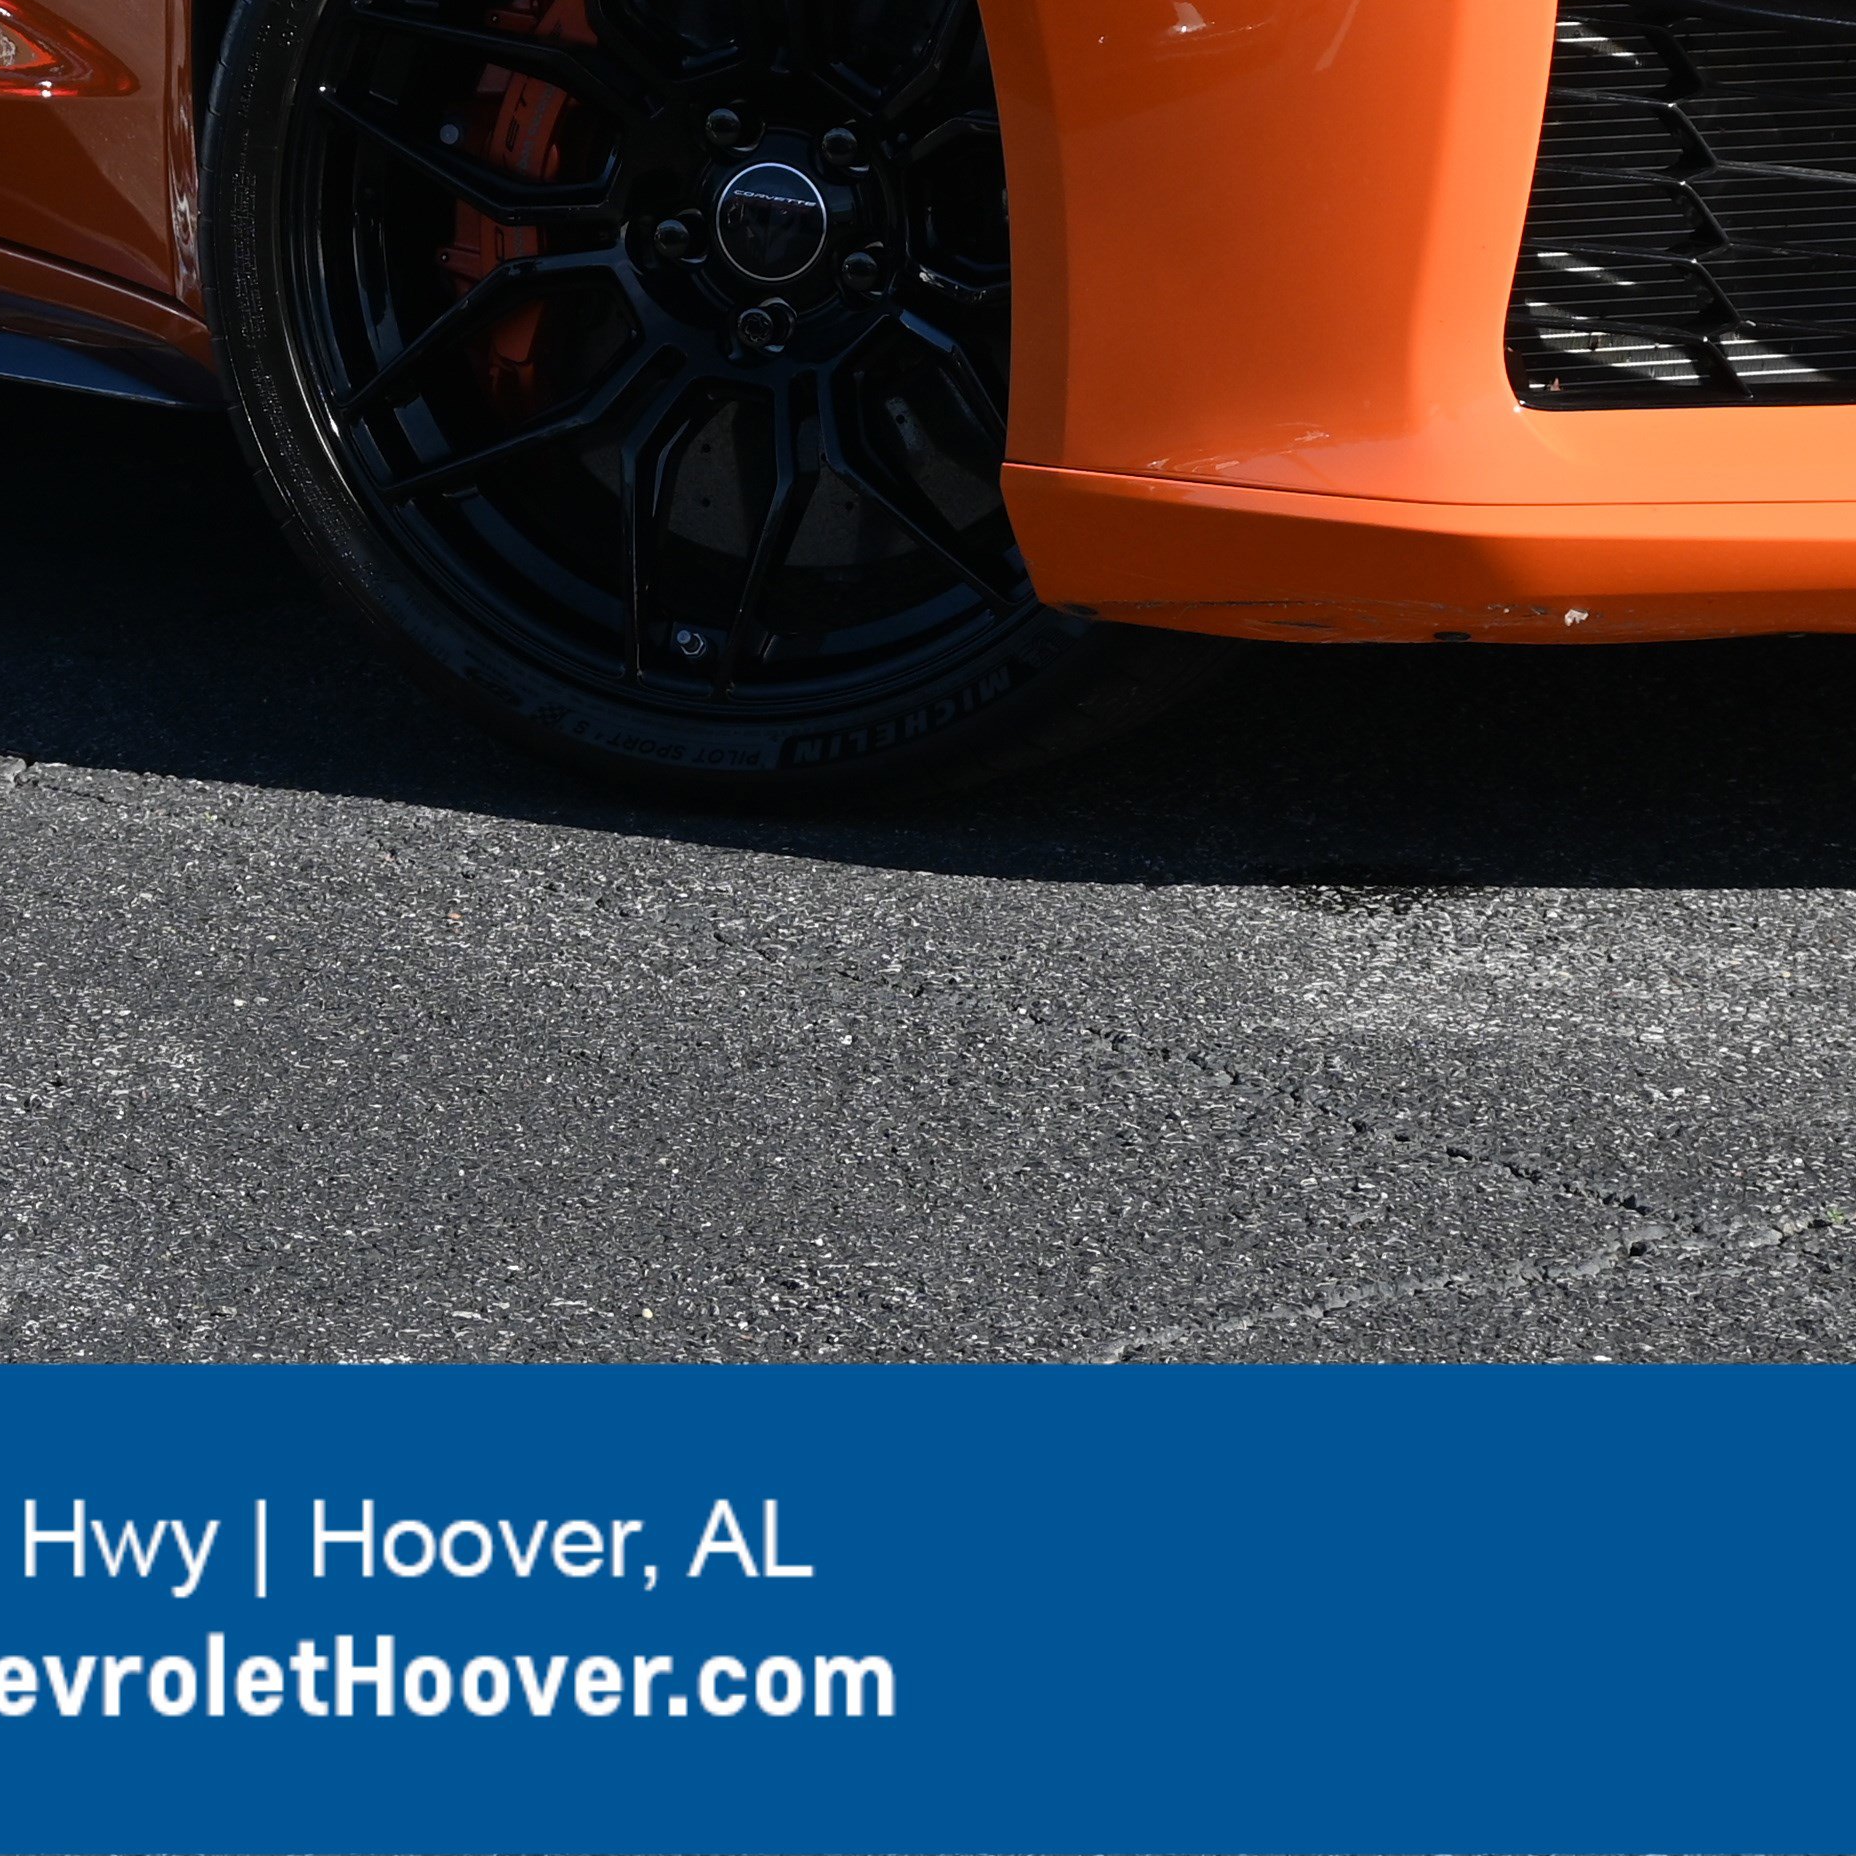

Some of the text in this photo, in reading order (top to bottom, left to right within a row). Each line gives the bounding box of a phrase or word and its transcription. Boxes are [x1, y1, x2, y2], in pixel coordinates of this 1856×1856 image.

[734, 189, 817, 207] CORVETTE
[793, 665, 1011, 766] MICHELIN
[609, 730, 687, 761] SPORT
[691, 748, 762, 767] PILOT
